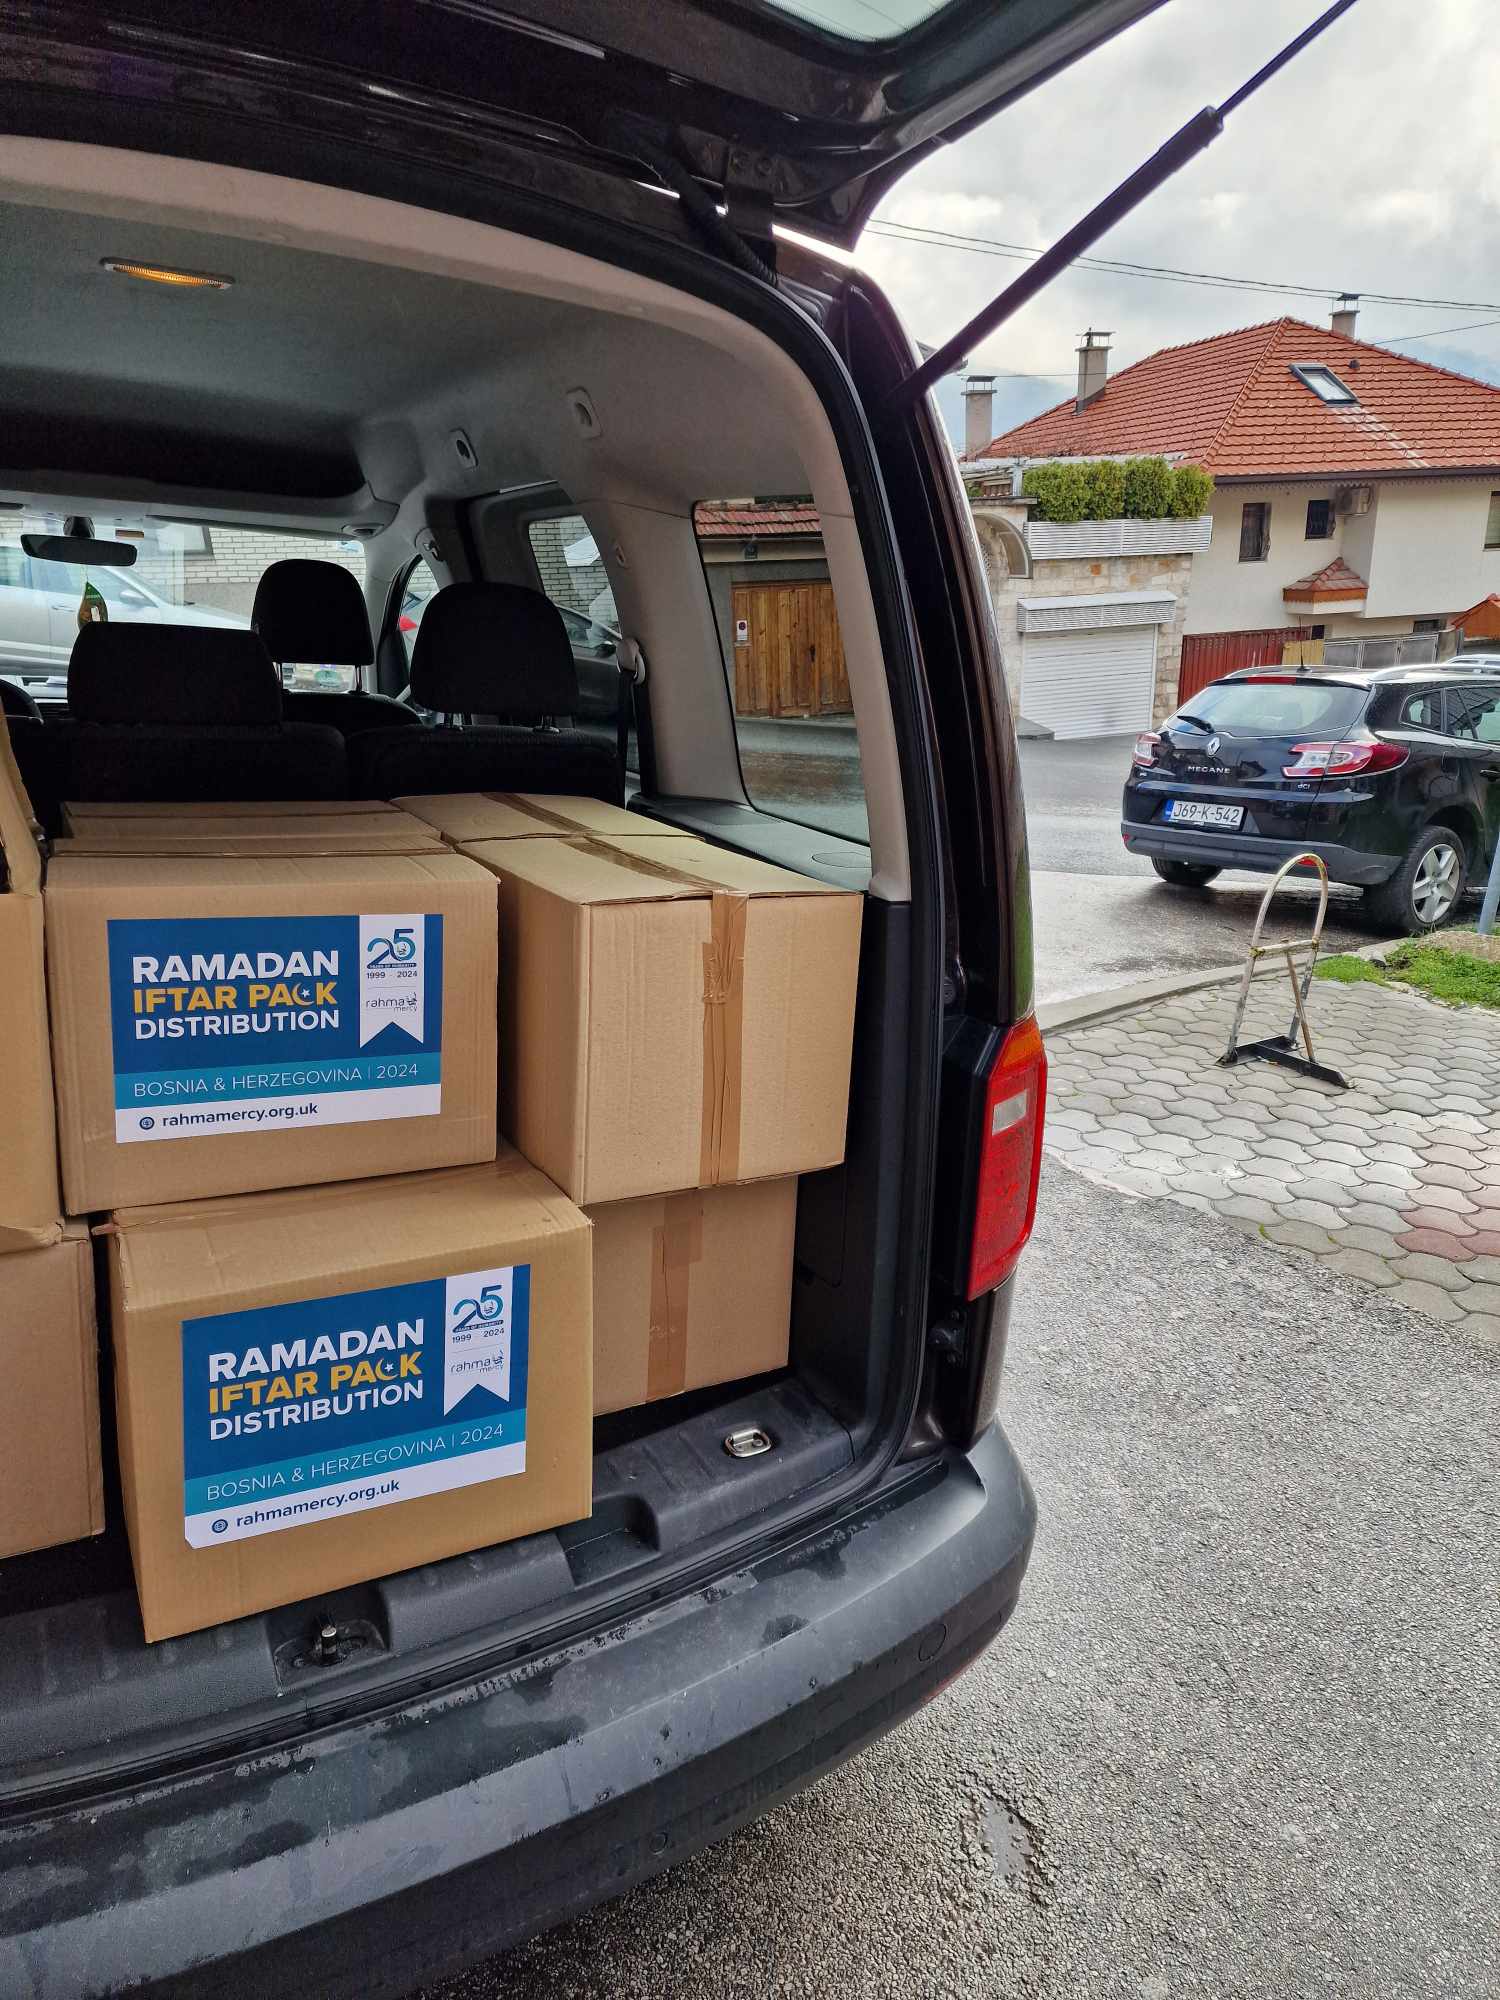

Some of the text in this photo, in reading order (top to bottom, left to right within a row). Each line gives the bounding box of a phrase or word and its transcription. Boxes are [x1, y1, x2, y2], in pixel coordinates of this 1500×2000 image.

[1173, 803, 1240, 824] J69-K-542
[132, 950, 339, 984] RAMADAN
[367, 971, 386, 979] 1999
[396, 970, 418, 978] 2024
[134, 981, 338, 1013] IFTAR PACK
[366, 996, 405, 1008] rahma
[135, 1009, 340, 1040] DISTRIBUTION
[134, 1078, 208, 1098] BOSNIA
[213, 1076, 227, 1091] &
[232, 1065, 363, 1090] HERZEGOVINA
[376, 1063, 419, 1080] 2024
[162, 1102, 319, 1128] rahmamercy.org.uk
[208, 1318, 425, 1383] RAMADAN
[452, 1328, 505, 1344] 1999 2024
[450, 1358, 491, 1373] rahma
[208, 1351, 422, 1414] IFTAR PACK
[210, 1379, 424, 1441] DISTRIBUTION
[207, 1471, 286, 1501] BOSNIA
[291, 1467, 305, 1482] &
[310, 1437, 446, 1478] HERZEGOVINA
[461, 1423, 504, 1446] 2024
[236, 1479, 400, 1528] rahmamercy.org.uk
